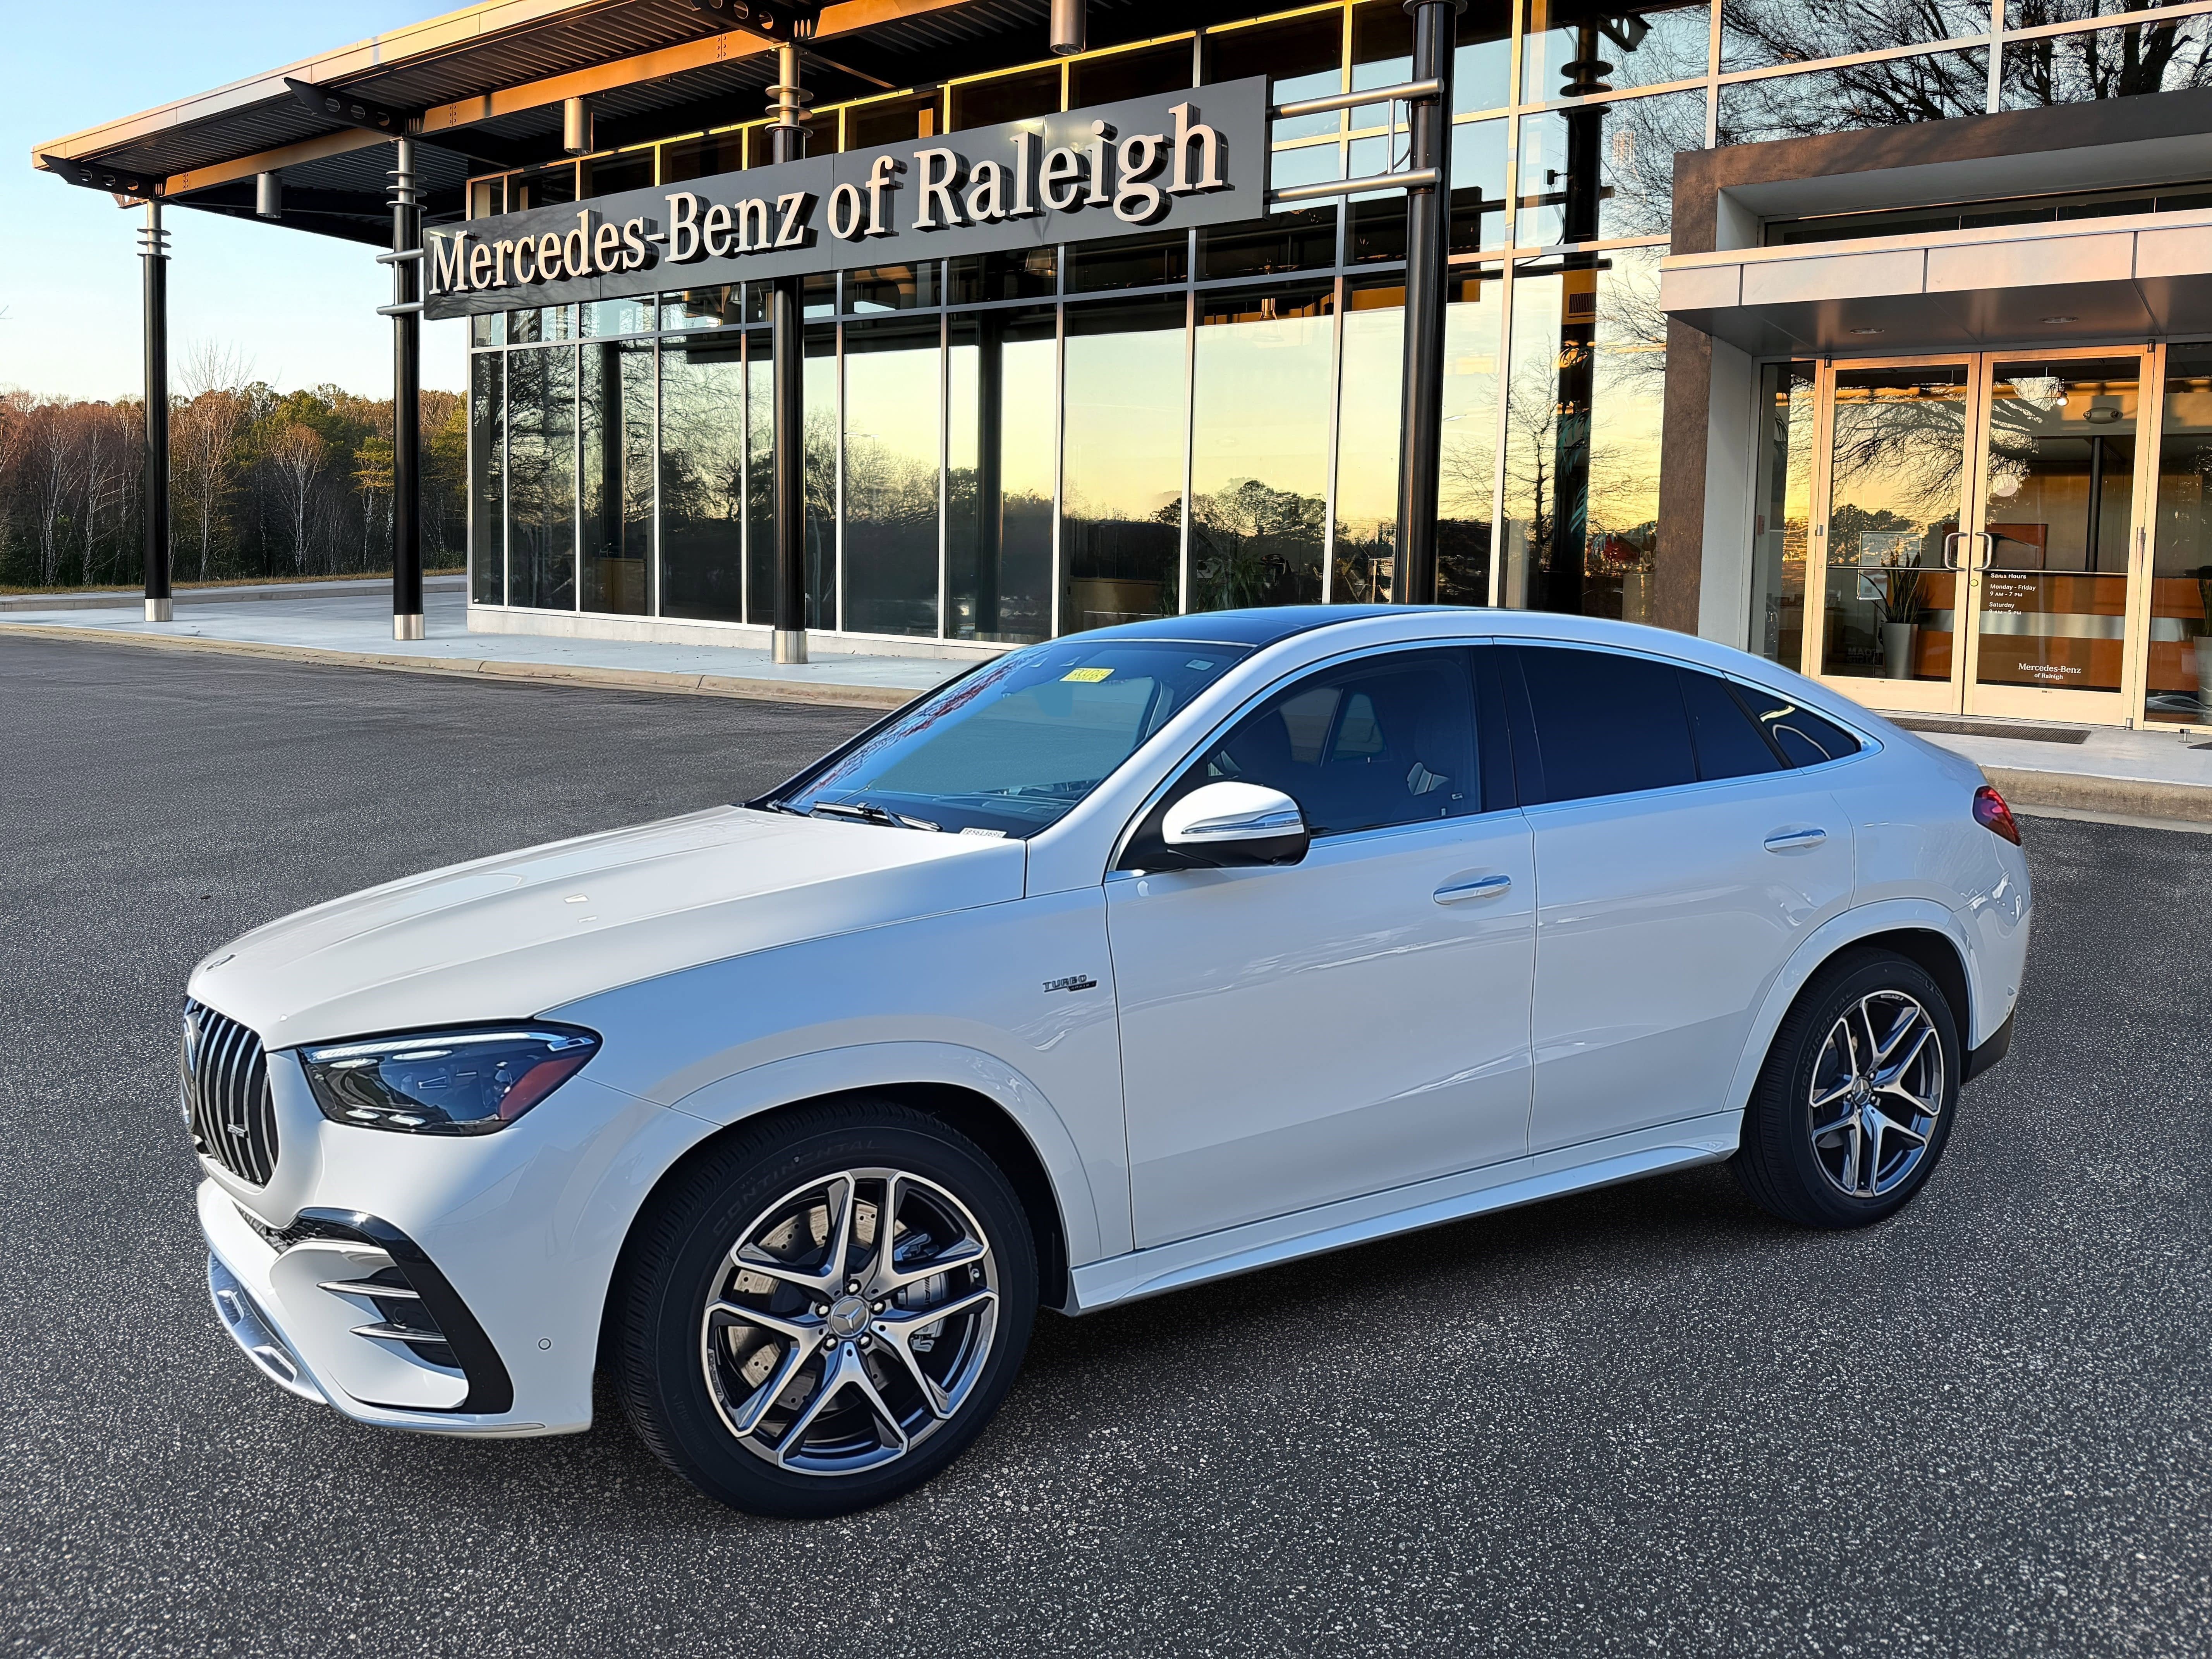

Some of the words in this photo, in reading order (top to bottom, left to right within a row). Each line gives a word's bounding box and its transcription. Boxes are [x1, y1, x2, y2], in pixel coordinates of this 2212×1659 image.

[428, 191, 807, 295] Mercedes-Benz
[827, 155, 894, 239] of
[911, 101, 1224, 223] Raleigh
[2018, 663, 2081, 673] Mercedes-Benz
[1042, 974, 1087, 989] TURBO
